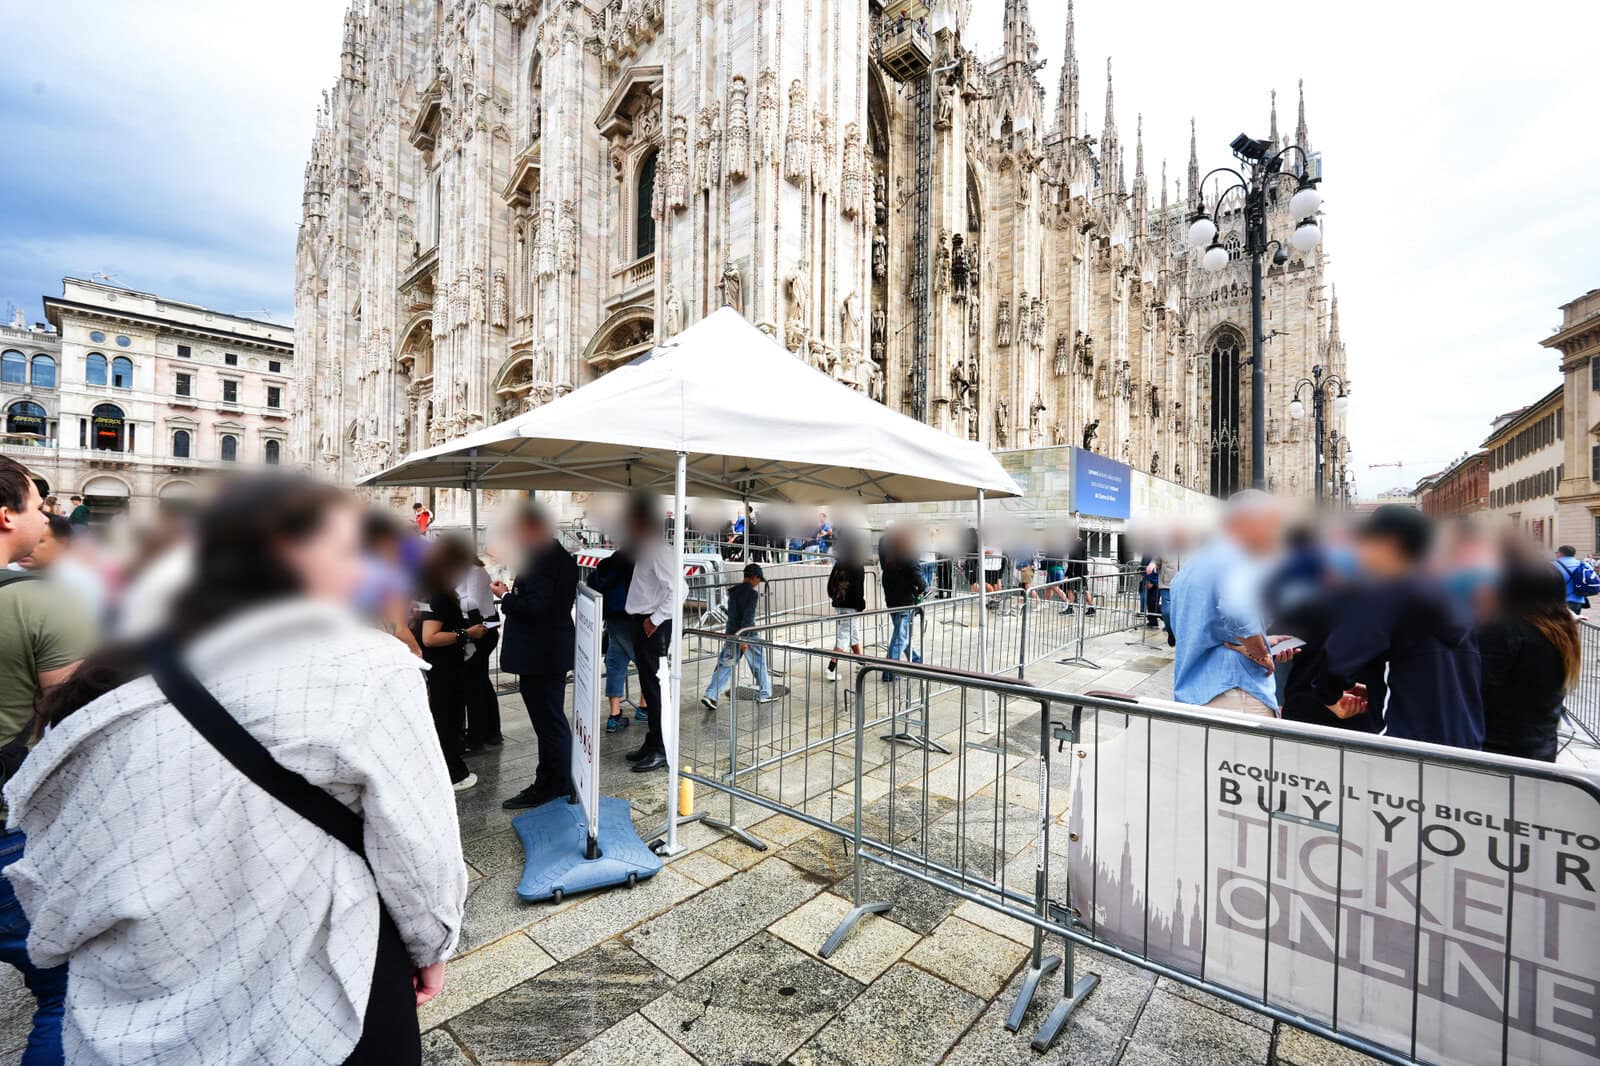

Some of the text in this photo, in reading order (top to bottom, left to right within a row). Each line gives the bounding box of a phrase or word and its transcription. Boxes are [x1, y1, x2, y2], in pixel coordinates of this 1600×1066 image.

[1218, 760, 1332, 795] ACQUISTA
[1367, 790, 1426, 813] TUO
[1219, 776, 1597, 893] BUY YOUR
[1217, 808, 1597, 961] TICKET
[1219, 877, 1597, 1047] ONLINE
